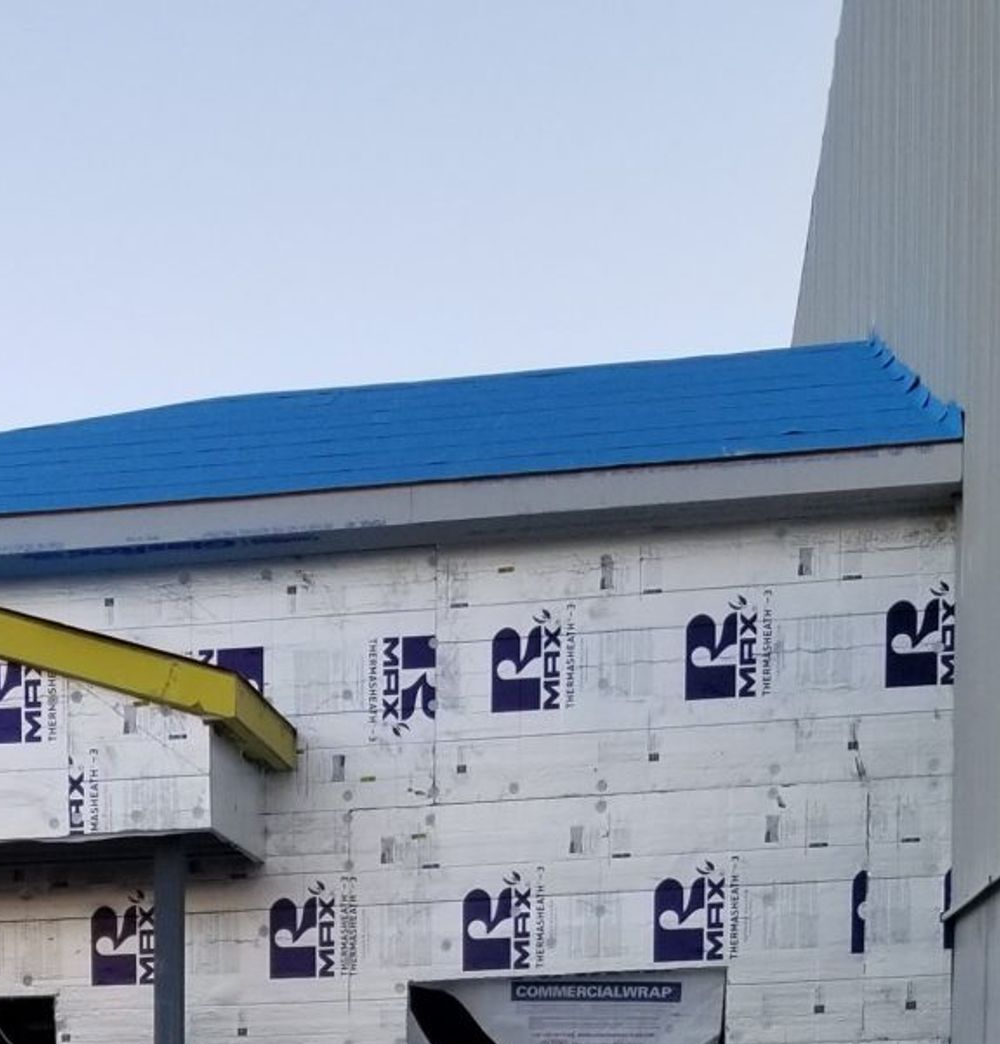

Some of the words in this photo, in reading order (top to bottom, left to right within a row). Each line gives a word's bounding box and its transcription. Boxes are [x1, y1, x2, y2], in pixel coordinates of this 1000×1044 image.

[382, 637, 400, 720] MAX
[543, 627, 561, 710] MAX
[739, 613, 758, 698] MAX
[940, 599, 956, 686] MAX
[68, 774, 84, 835] AX
[139, 907, 154, 984] MAX
[318, 897, 335, 977] MAX
[513, 888, 531, 970] MAX
[706, 877, 725, 961] MAX
[515, 985, 673, 998] COMMERCIALWRAP
